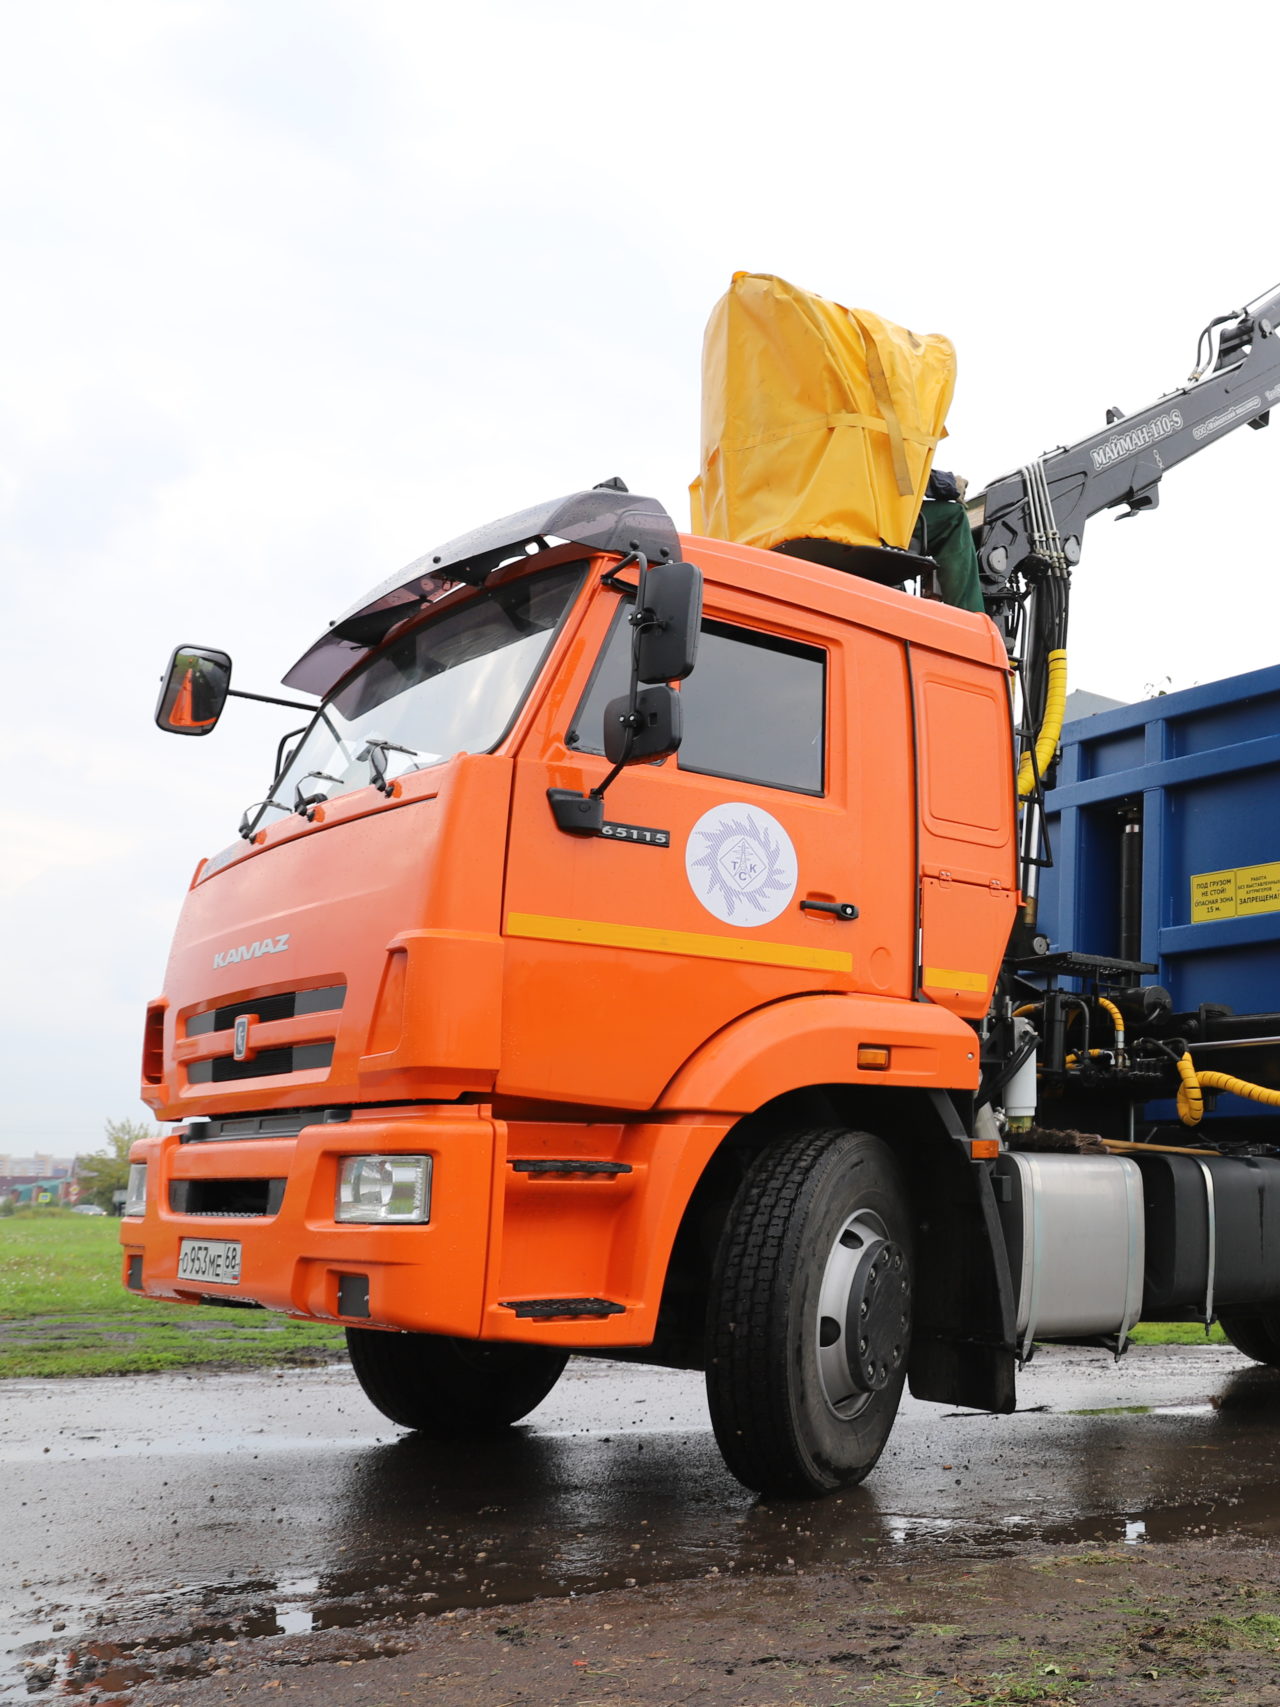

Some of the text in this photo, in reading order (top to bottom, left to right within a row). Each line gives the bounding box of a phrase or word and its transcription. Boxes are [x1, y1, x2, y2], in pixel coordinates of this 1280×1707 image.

[1091, 410, 1182, 469] МАЙМАН-110-S
[602, 826, 667, 843] 65115
[1196, 879, 1232, 890] ПОД ГРУЗОМ
[1210, 887, 1227, 896] СТОЙ!
[1195, 896, 1234, 908] ОПАСНАЯ ЗОНА
[1239, 893, 1280, 905] ЗАПРЕЩЕНА!
[213, 933, 290, 969] KAMAZ
[225, 1247, 237, 1270] 68
